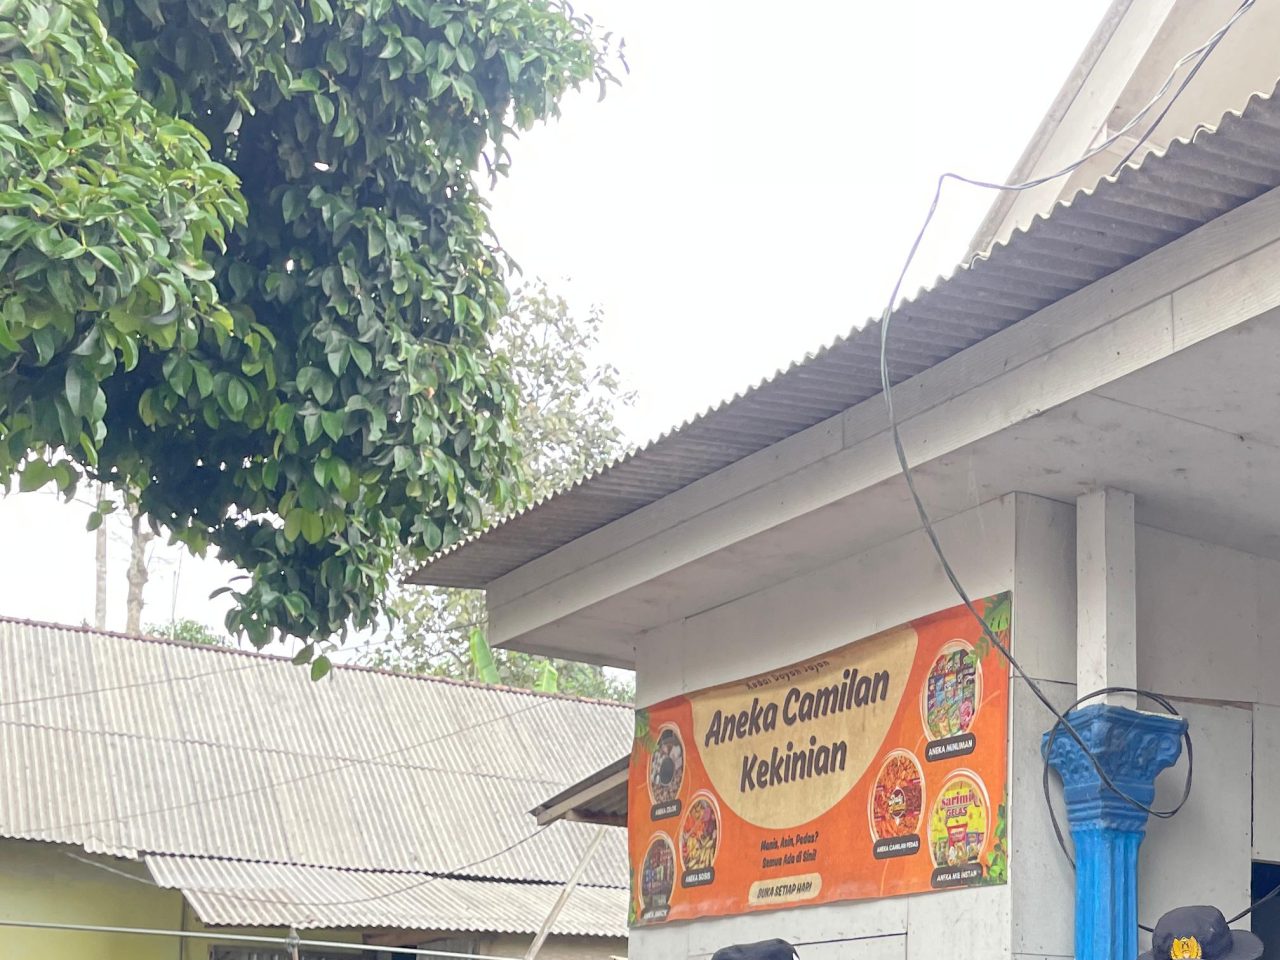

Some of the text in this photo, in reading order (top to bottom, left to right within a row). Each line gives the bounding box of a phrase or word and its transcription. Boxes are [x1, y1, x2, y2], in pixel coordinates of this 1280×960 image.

[704, 668, 889, 748] Aneka Camilan
[928, 744, 946, 756] ANEKA
[740, 735, 847, 793] Kekinian
[937, 869, 977, 882] ANEKA MIE INSTAN
[757, 881, 813, 898] BUKA SETIAP HARI
